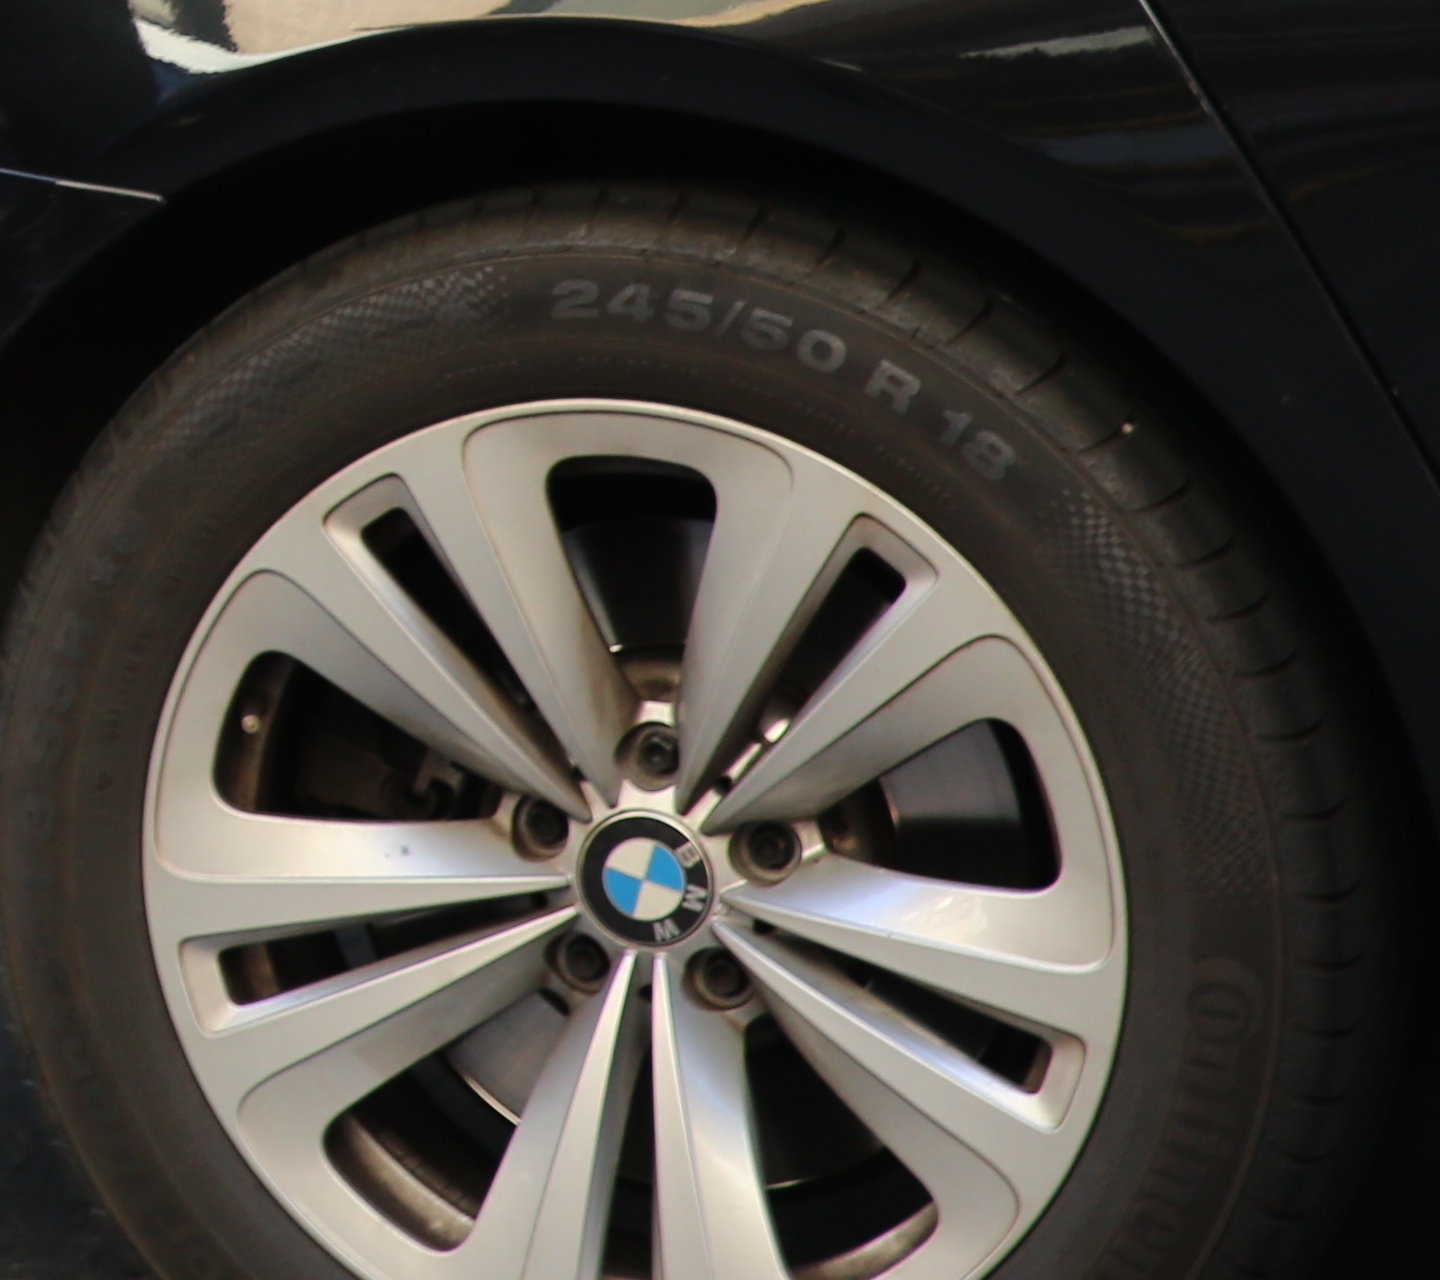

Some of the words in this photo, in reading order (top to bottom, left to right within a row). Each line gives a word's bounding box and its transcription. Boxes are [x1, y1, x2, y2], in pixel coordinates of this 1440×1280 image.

[550, 278, 848, 374] 245/50
[864, 359, 922, 415] R
[938, 407, 1018, 482] 18
[650, 840, 709, 942] BMW
